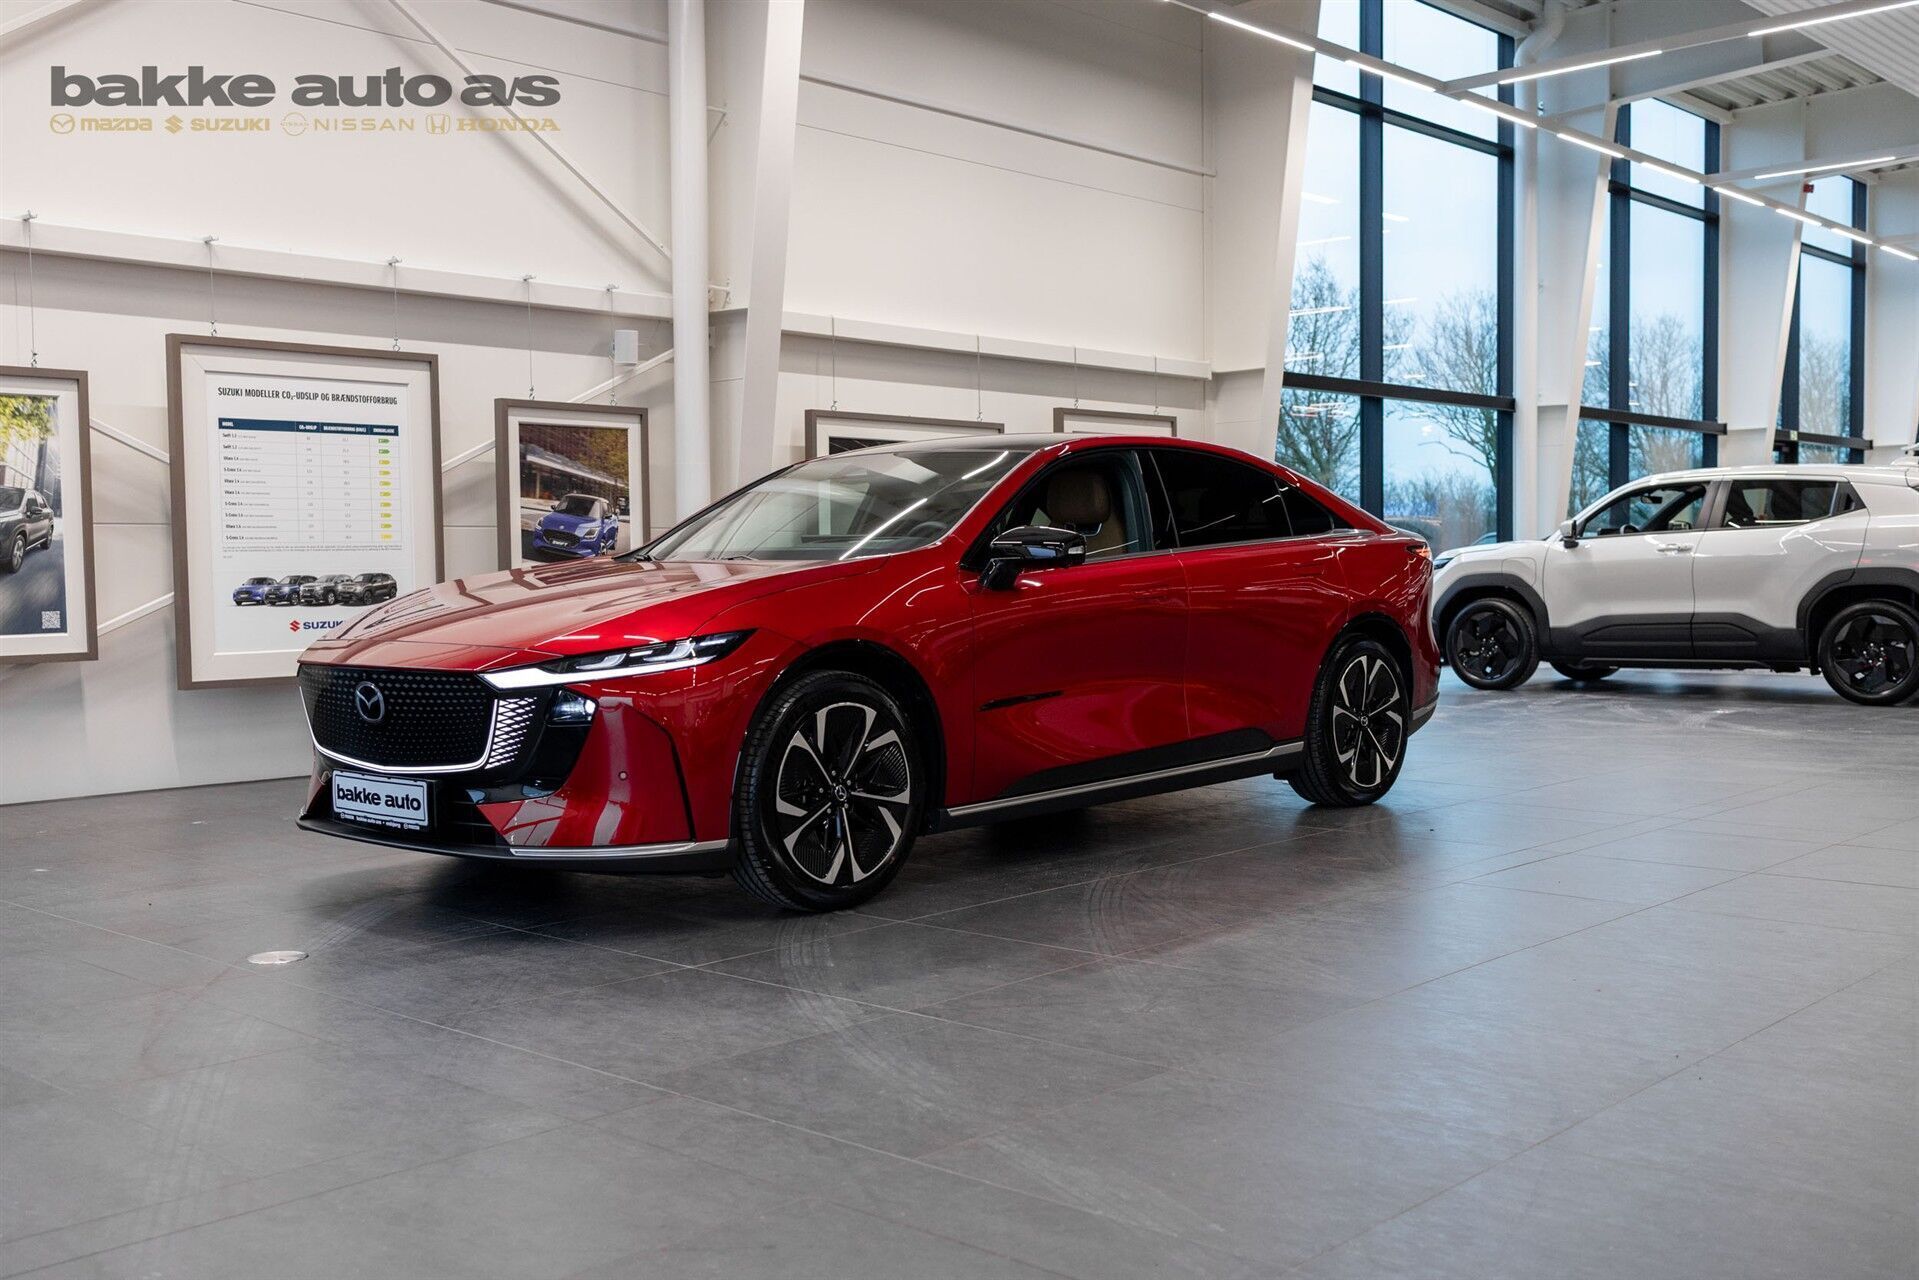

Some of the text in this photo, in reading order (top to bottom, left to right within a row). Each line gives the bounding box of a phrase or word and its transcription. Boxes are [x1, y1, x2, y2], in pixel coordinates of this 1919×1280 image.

[217, 387, 243, 397] SUZUKI
[245, 389, 280, 399] MODELLER
[320, 392, 330, 401] OG
[331, 393, 398, 405] BRÆNDSTOFFORBRUG
[303, 620, 344, 630] SUZUK
[336, 784, 422, 811] bakke auto
